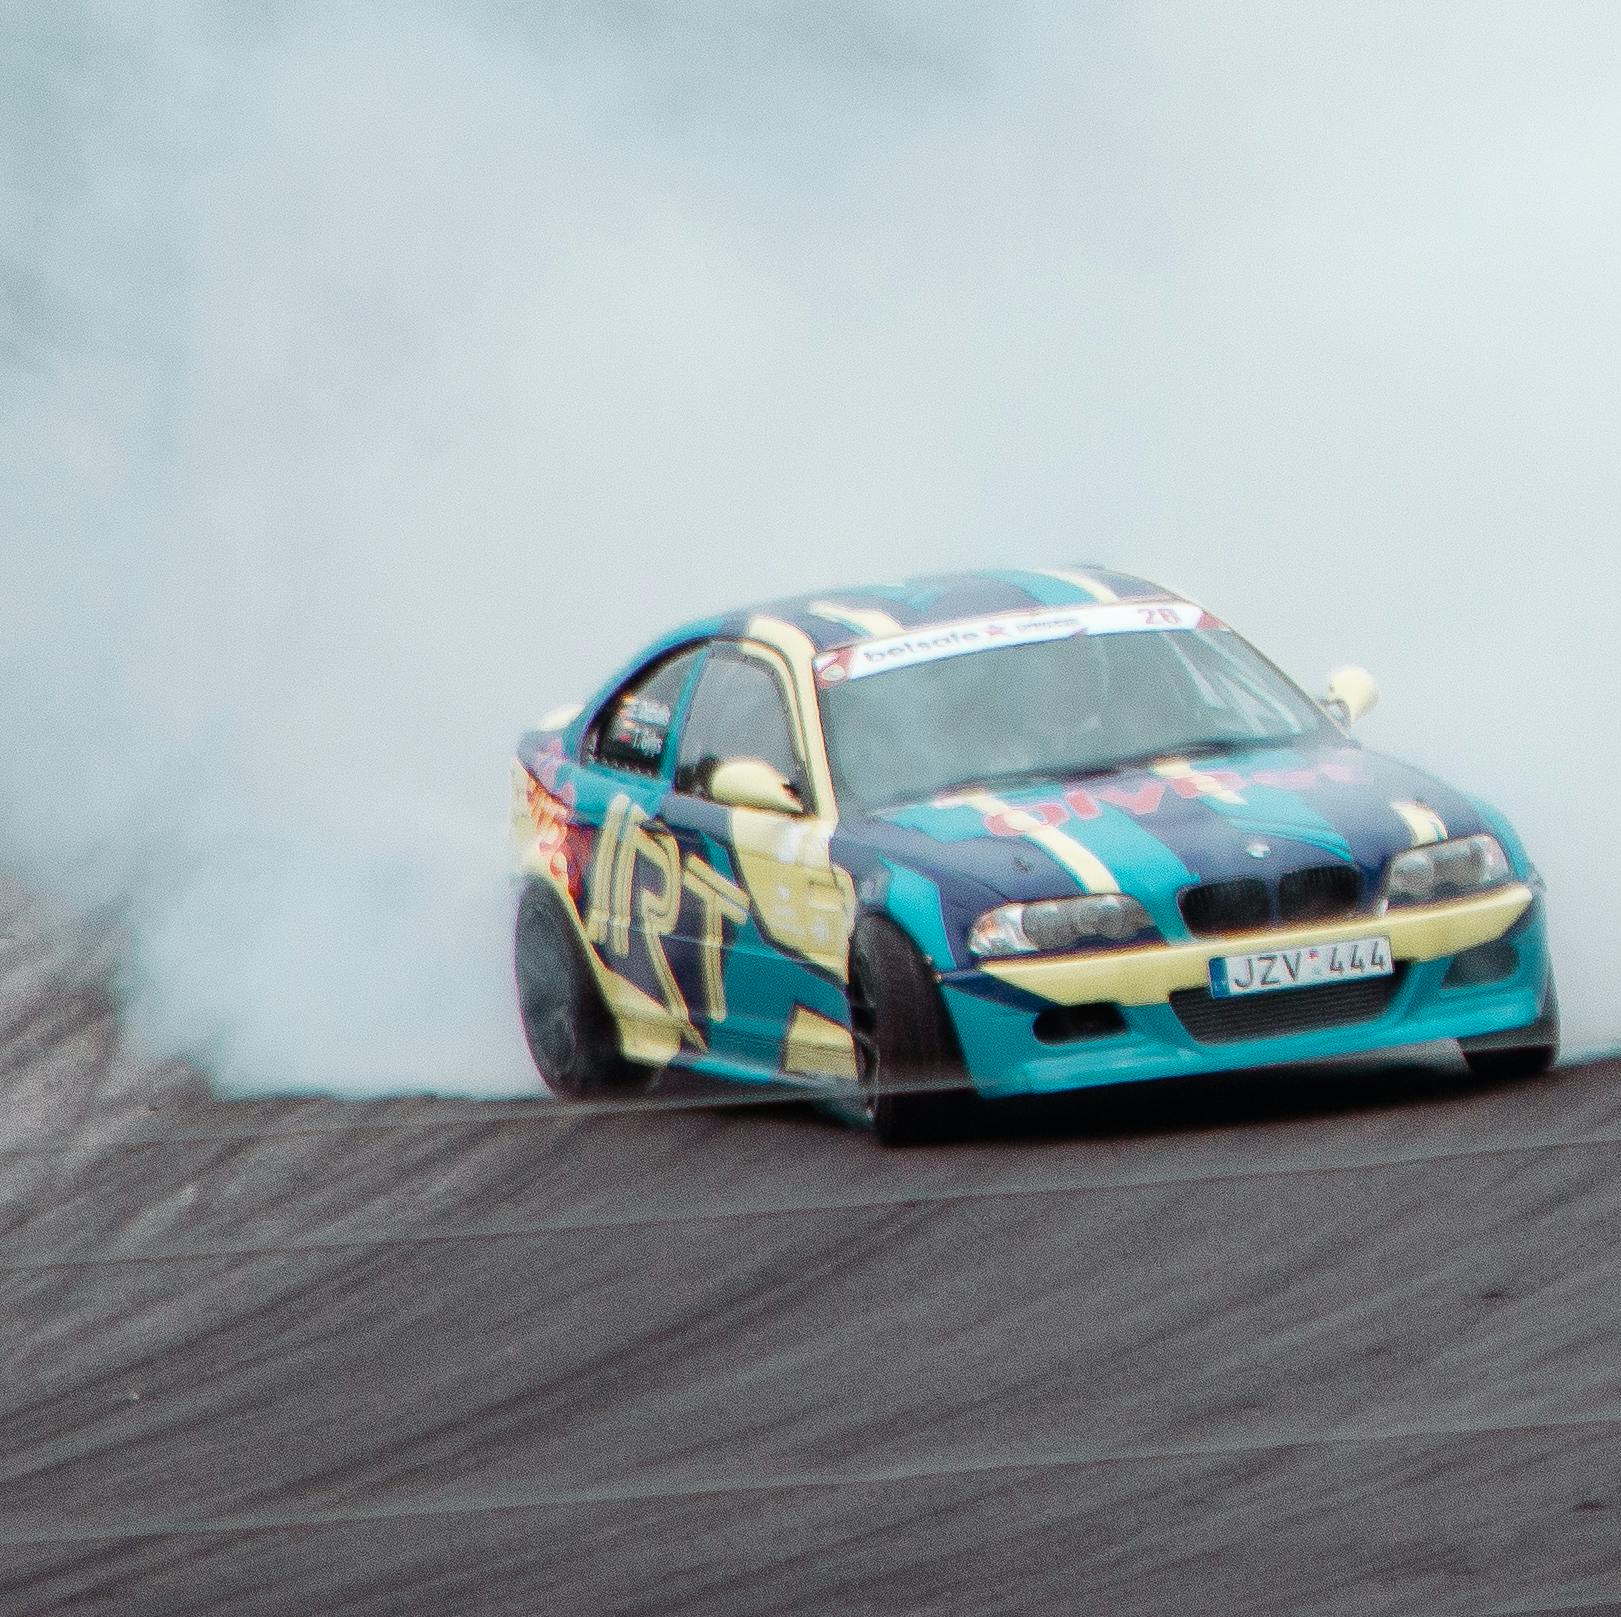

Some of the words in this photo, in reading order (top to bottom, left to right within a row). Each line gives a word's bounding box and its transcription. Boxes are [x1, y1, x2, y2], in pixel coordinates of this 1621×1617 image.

[864, 630, 980, 663] betsafe
[1234, 951, 1302, 988] JZV
[1329, 940, 1385, 975] 444
